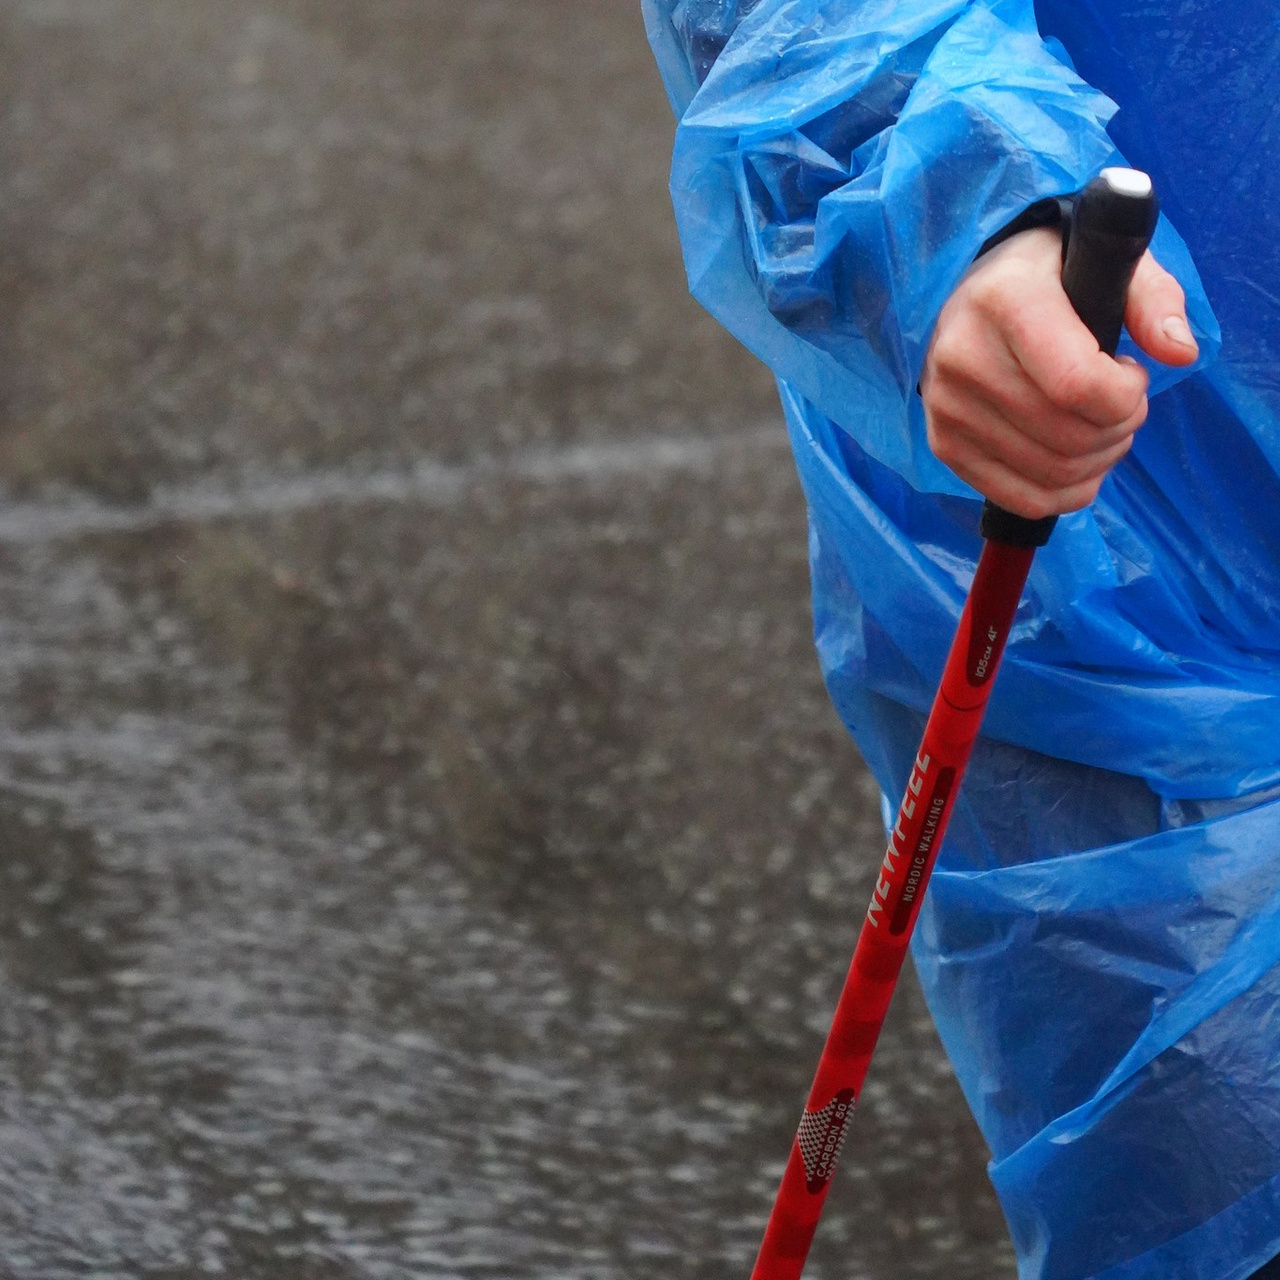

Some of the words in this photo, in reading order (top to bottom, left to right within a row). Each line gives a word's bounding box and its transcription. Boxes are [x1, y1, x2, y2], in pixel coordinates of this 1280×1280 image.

[867, 751, 931, 928] NEWFEEL
[903, 855, 926, 903] NORDIC
[918, 797, 945, 853] WALKING
[816, 1124, 840, 1178] CARBON
